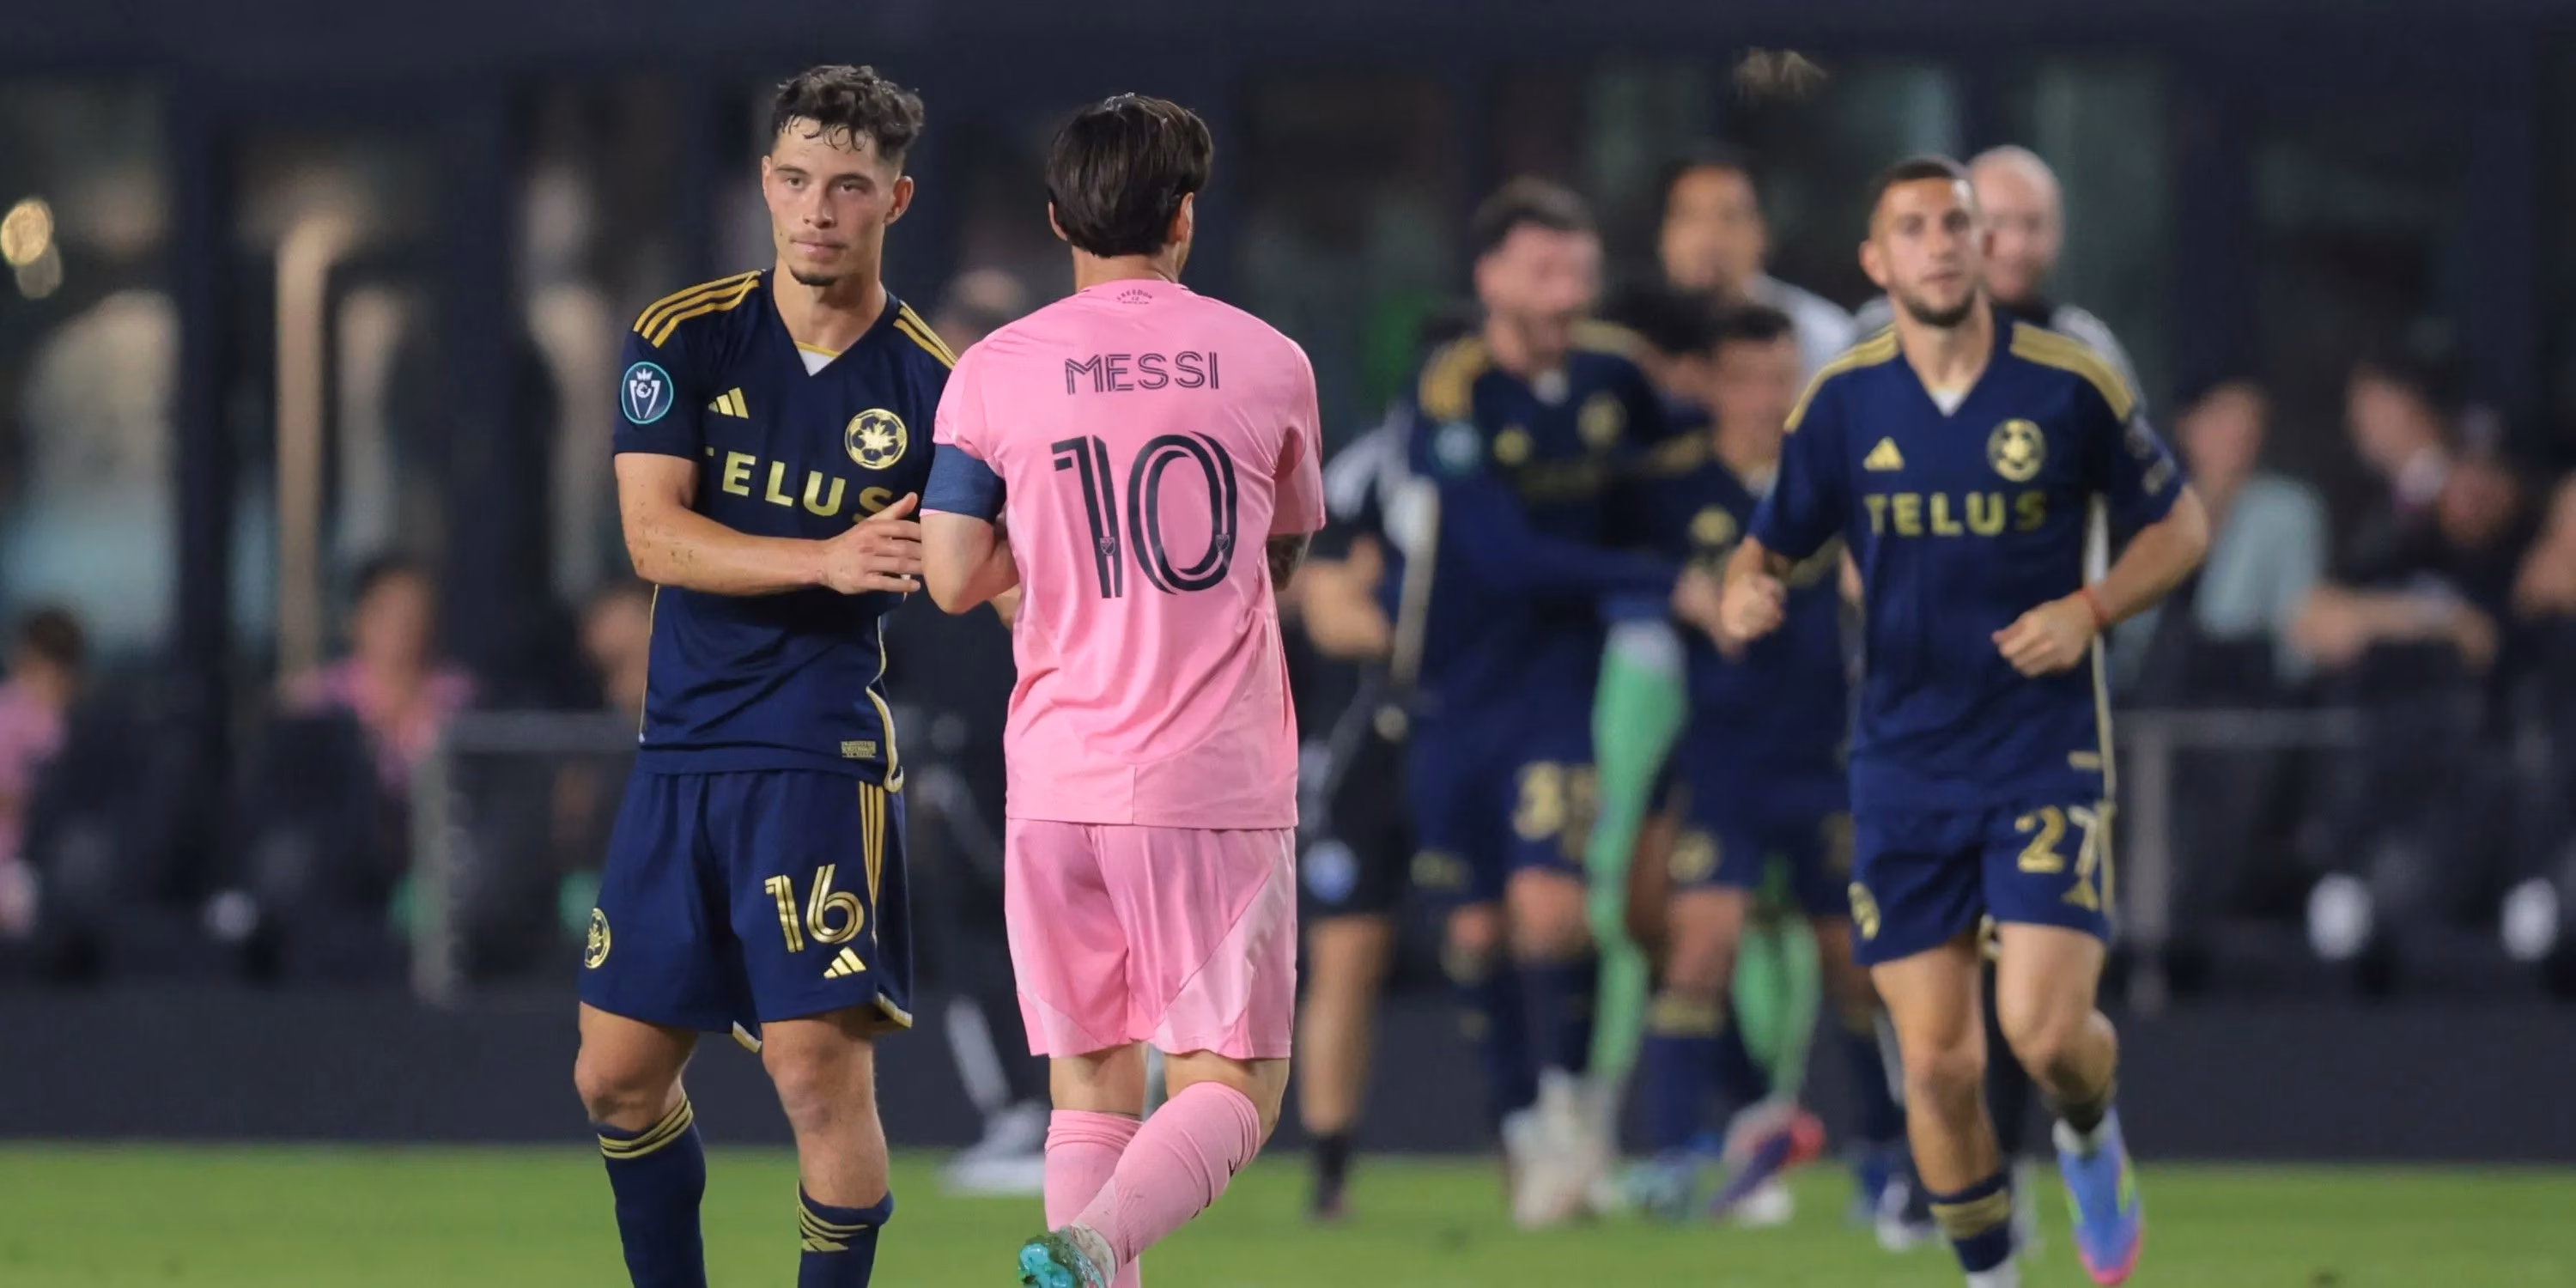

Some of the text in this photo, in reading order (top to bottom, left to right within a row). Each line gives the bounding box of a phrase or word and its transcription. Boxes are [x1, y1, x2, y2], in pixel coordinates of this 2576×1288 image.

[1065, 350, 1220, 396] MESSI
[1051, 431, 1237, 599] 10
[1864, 490, 2047, 538] TELUS
[2014, 805, 2099, 878] 27
[764, 864, 865, 953] 16
